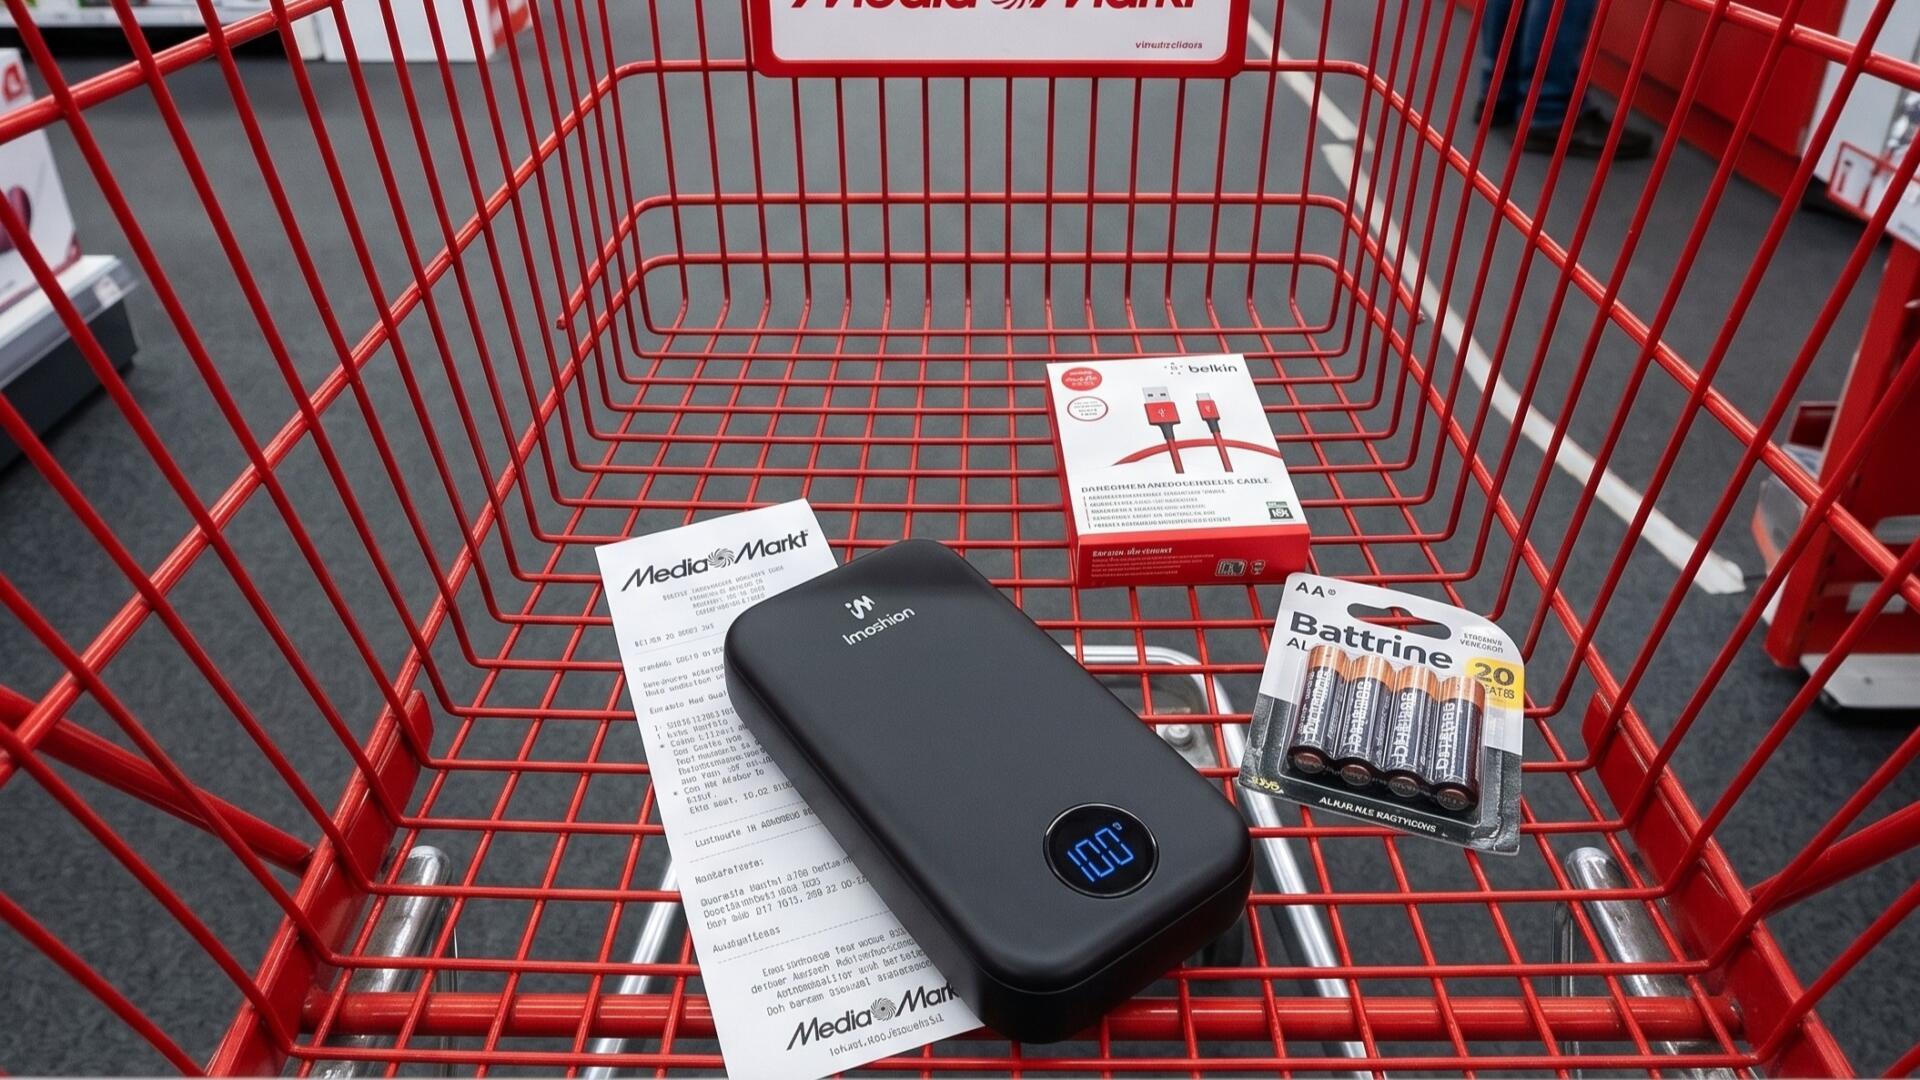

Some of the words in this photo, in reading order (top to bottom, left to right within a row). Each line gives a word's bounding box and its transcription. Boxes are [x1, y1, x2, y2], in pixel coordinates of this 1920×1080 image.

[1188, 363, 1237, 373] belkin
[622, 558, 708, 592] Media
[735, 530, 807, 564] Markt
[1290, 611, 1453, 669] Battrine
[1474, 662, 1515, 686] 20
[787, 1010, 872, 1050] Media
